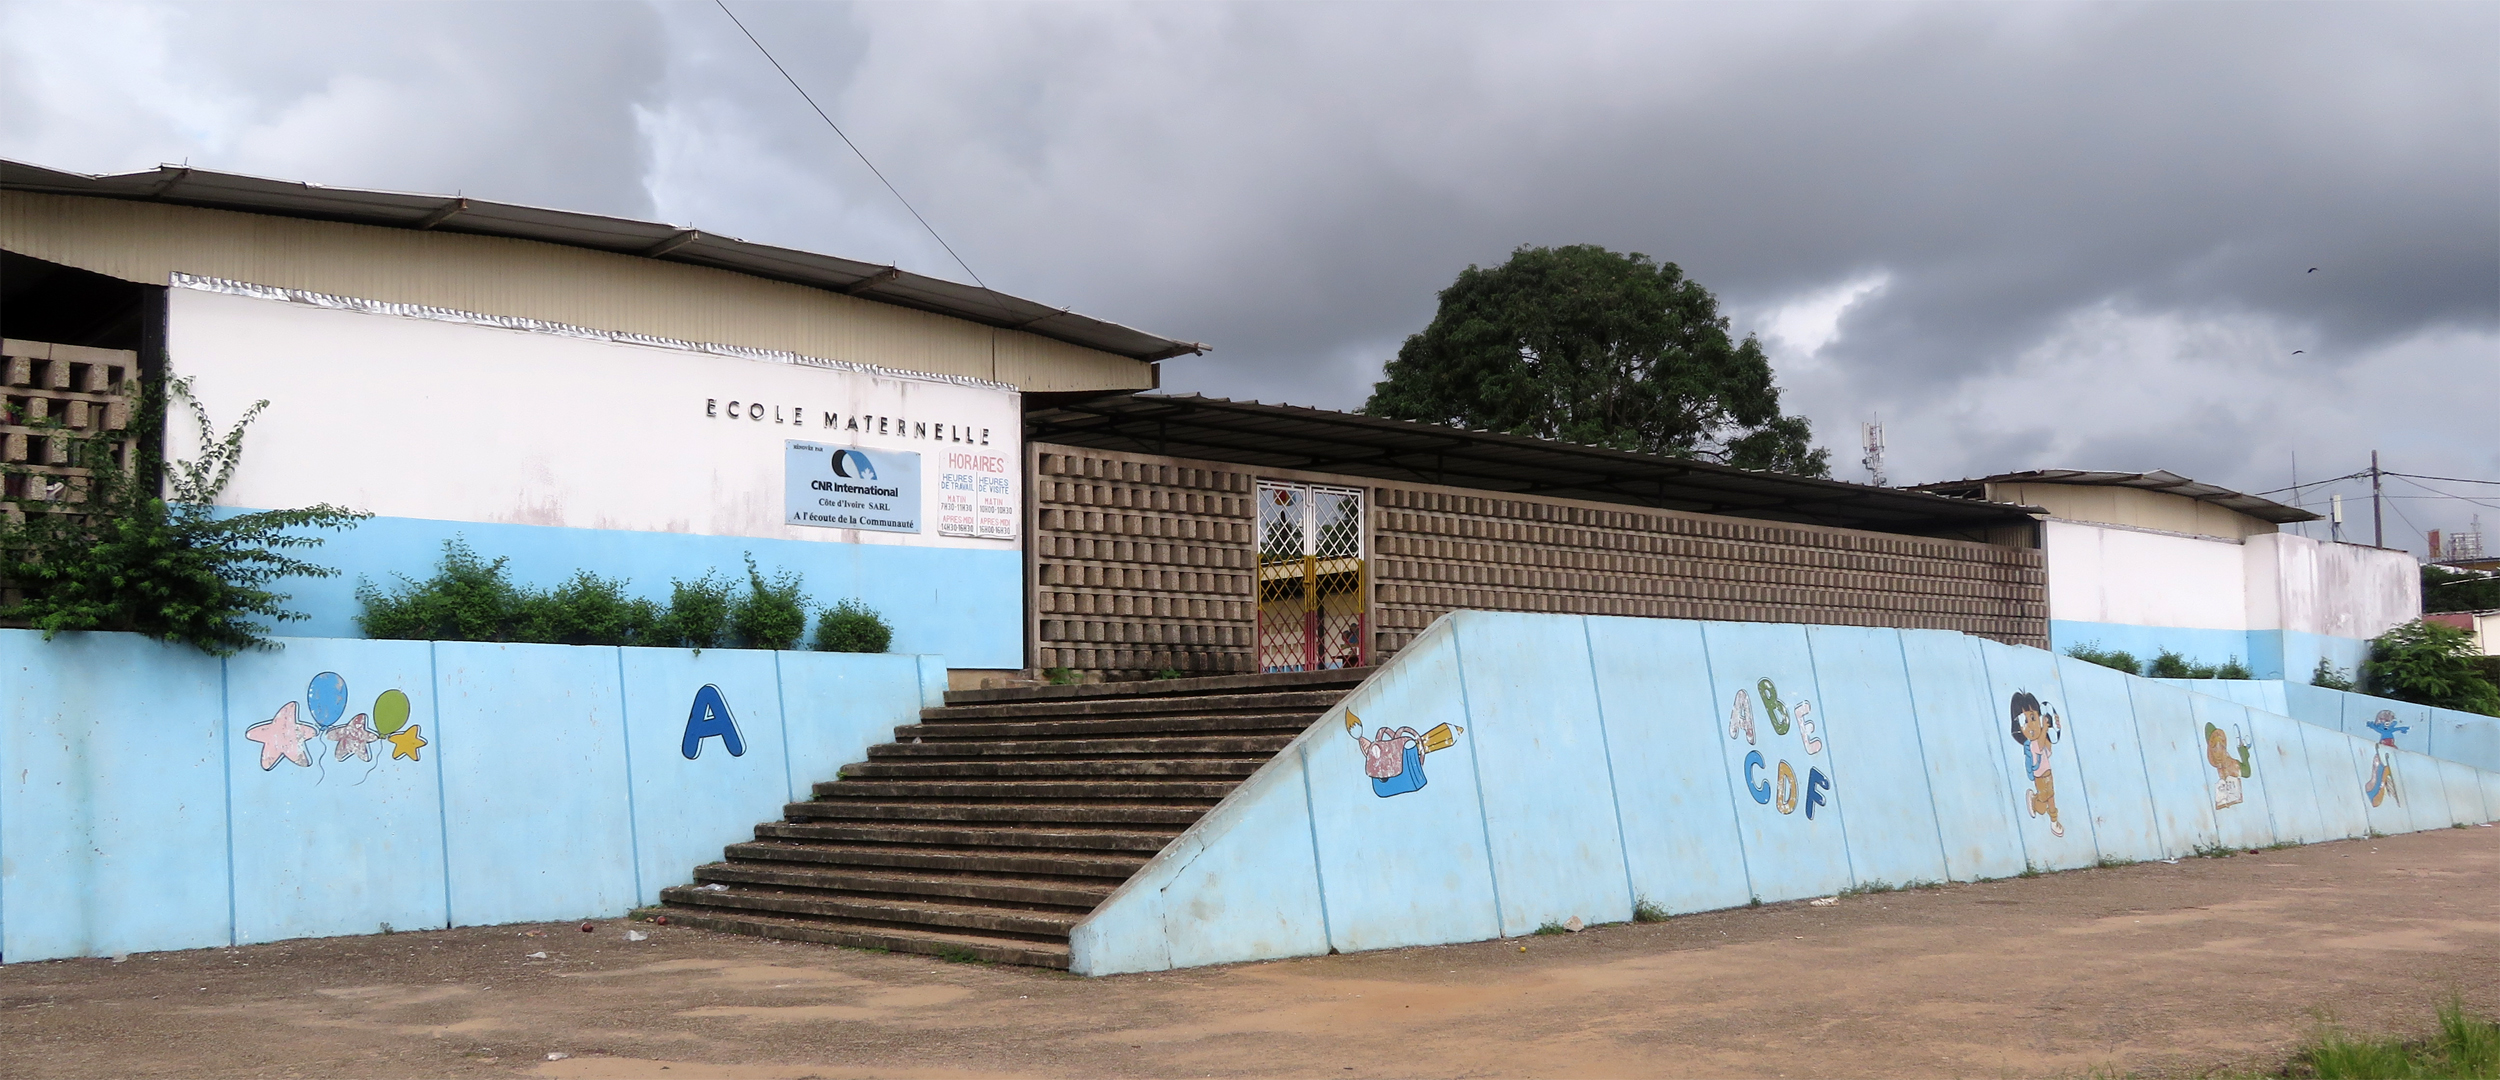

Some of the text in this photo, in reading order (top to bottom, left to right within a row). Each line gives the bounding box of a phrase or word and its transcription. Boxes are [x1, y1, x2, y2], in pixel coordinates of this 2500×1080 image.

[706, 398, 990, 445] ECOLE MATERNELLE
[949, 452, 1004, 473] HORAIRES
[942, 473, 973, 483] HEURES
[979, 477, 1009, 486] HEURES
[811, 480, 898, 497] CNR International
[941, 482, 974, 491] DE TRAVAIL
[979, 485, 1009, 495] DE VISITE
[818, 498, 890, 511] Côte d'Ivoire SARL
[947, 495, 966, 503] MATIN
[984, 497, 1004, 506] MATIN
[793, 511, 801, 520] A
[837, 514, 848, 523] de
[849, 515, 857, 524] la
[859, 516, 914, 528] Communauté
[681, 683, 747, 760] A
